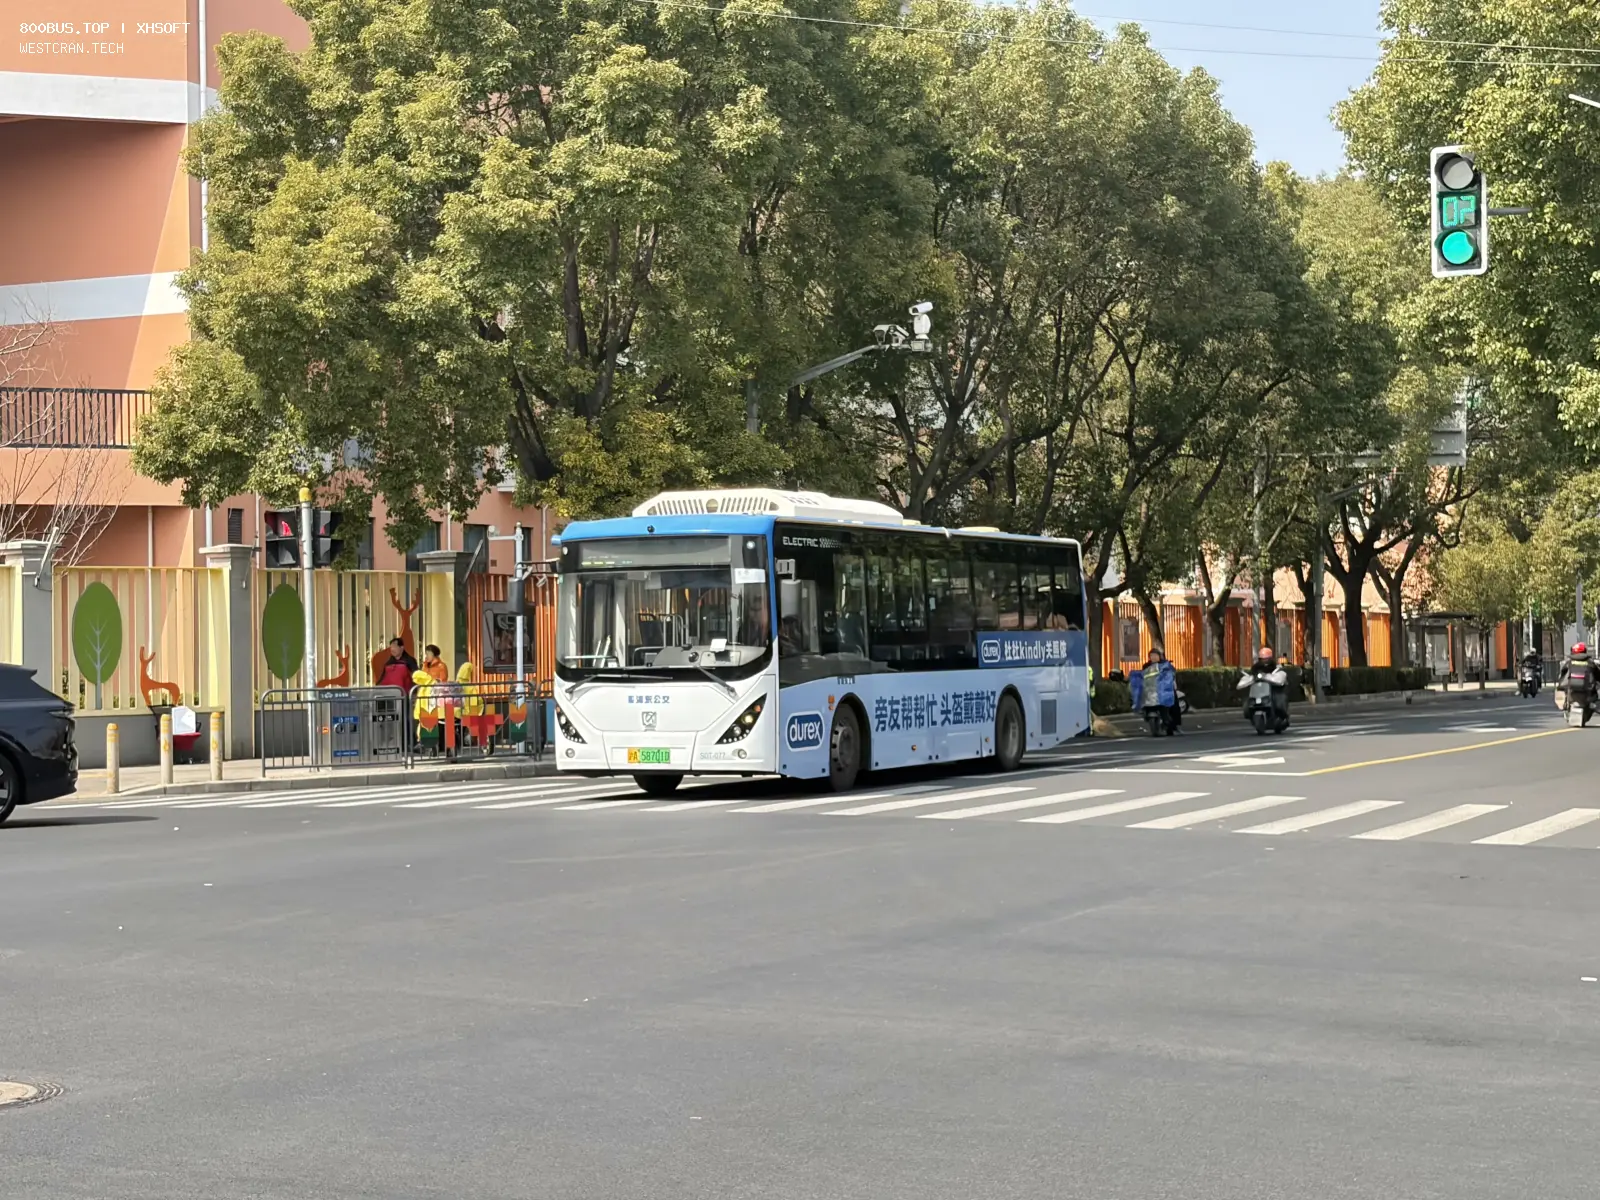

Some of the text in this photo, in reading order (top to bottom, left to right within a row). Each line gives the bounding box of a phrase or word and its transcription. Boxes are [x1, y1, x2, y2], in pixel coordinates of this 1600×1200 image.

[782, 536, 819, 548] ELECTRIC
[874, 690, 997, 732] 旁友帮帮忙 头盔戴戴好
[789, 718, 822, 741] durex
